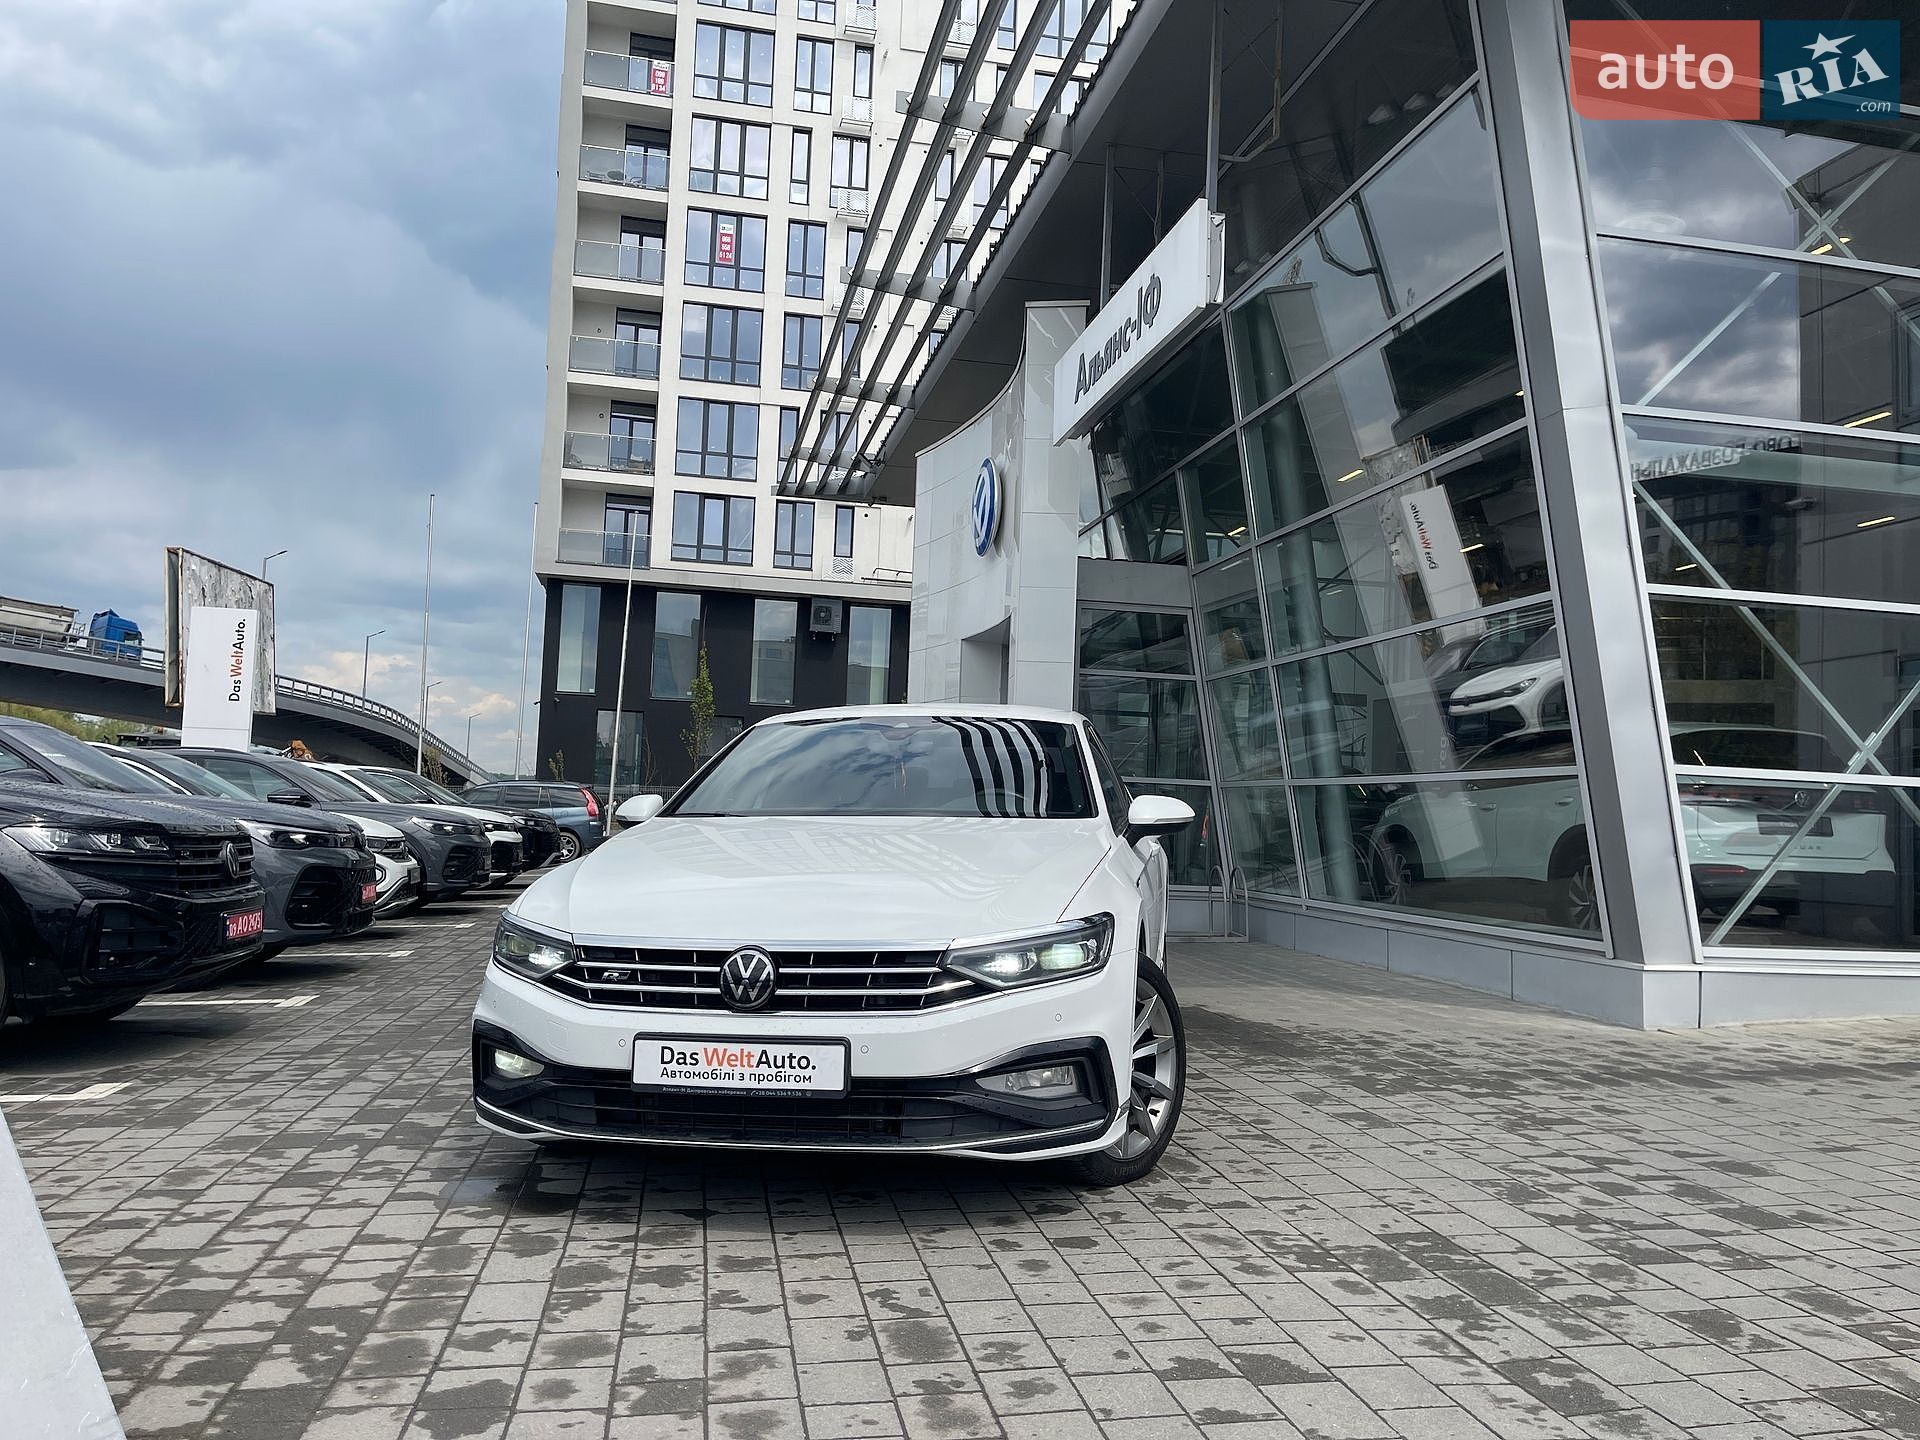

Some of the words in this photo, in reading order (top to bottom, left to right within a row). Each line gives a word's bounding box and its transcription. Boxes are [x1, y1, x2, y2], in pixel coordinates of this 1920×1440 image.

[1074, 273, 1162, 405] Альянс-ІФ
[230, 618, 246, 678] WeltAuto.
[228, 679, 242, 702] Das
[660, 1046, 699, 1066] Das
[703, 1047, 817, 1070] WeltAuto.
[660, 1066, 735, 1081] Автомобілі
[738, 1073, 745, 1081] з
[750, 1070, 812, 1084] пробігом
